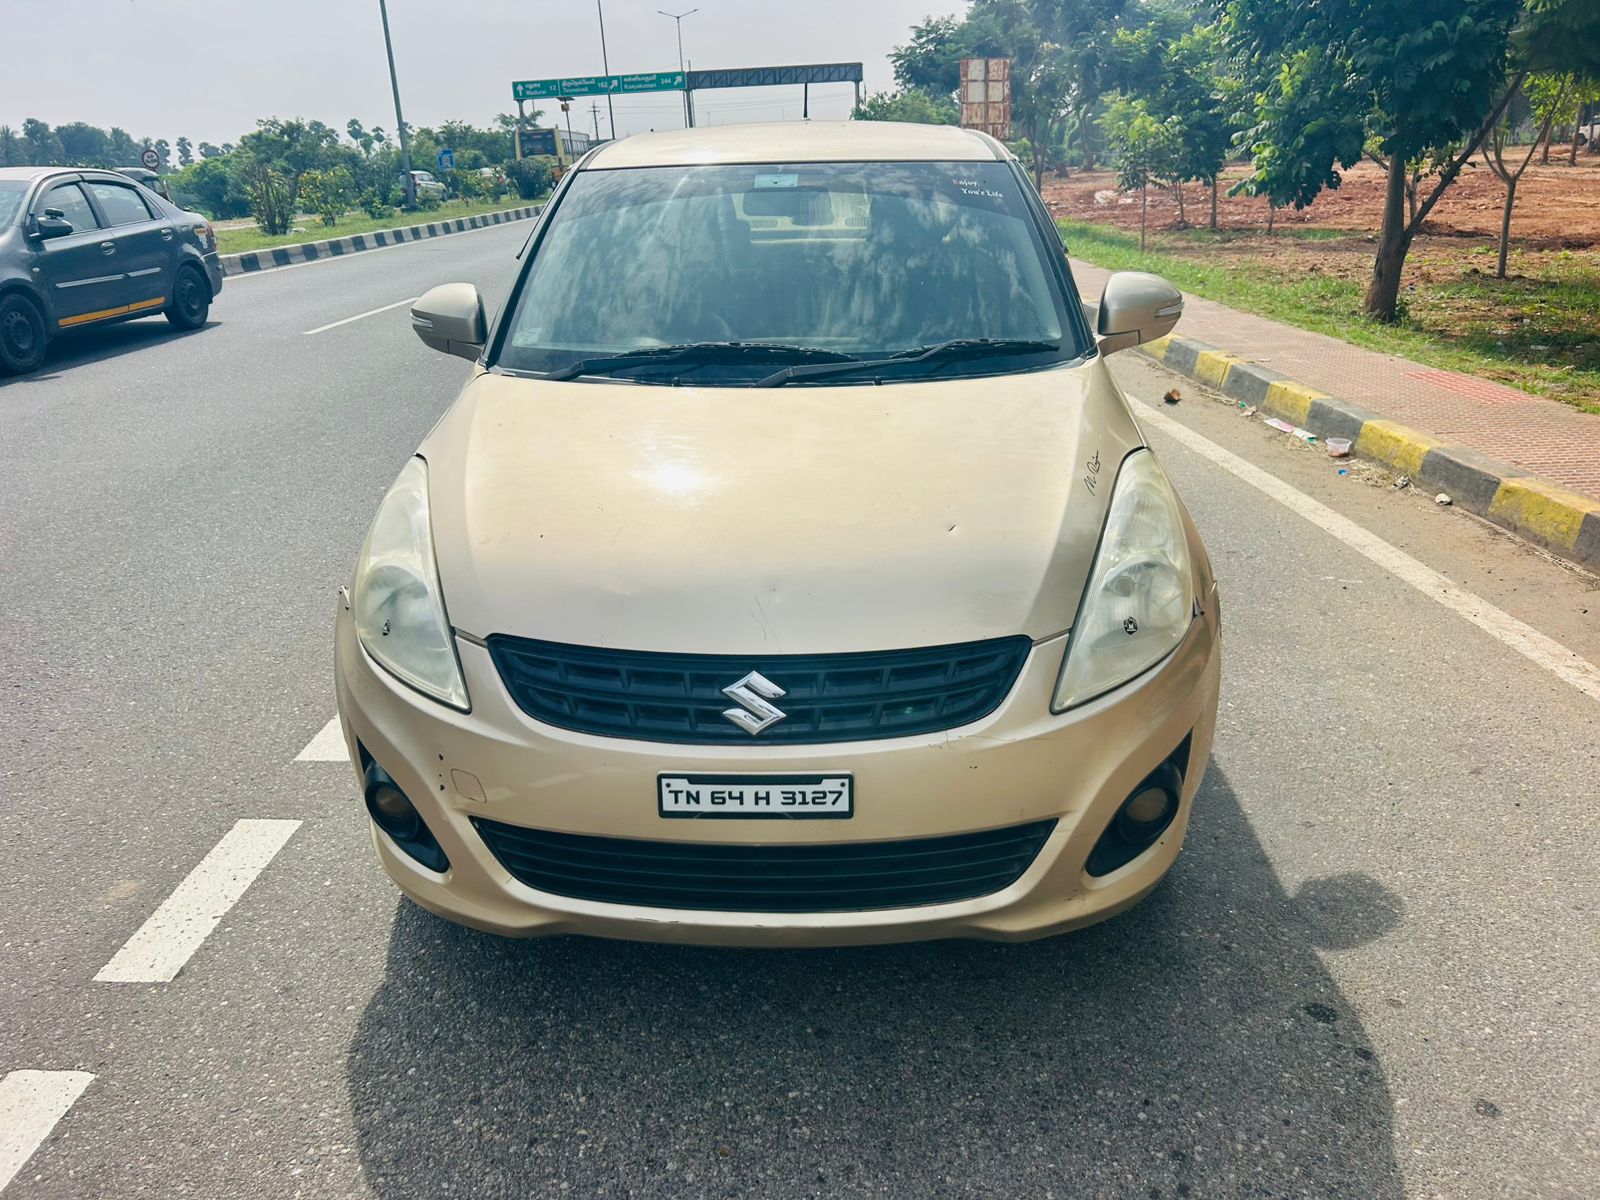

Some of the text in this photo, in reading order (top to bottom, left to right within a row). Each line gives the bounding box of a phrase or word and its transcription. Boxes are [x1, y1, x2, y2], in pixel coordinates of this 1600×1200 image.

[952, 178, 977, 187] Enjoy
[668, 790, 843, 806] TN 64 H 3127
